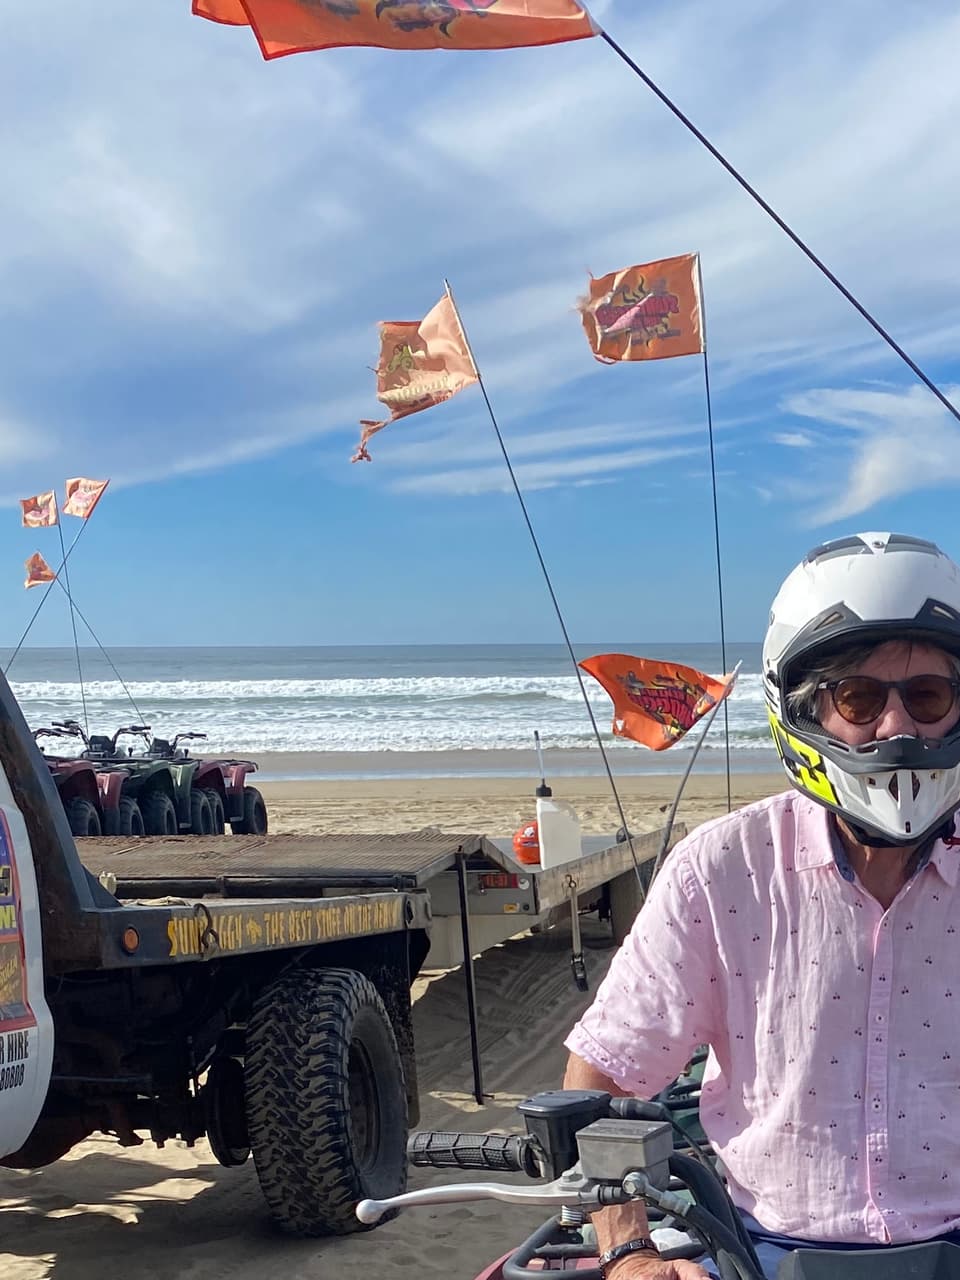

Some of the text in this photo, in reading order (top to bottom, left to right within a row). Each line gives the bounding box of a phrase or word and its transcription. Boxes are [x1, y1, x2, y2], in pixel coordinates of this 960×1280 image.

[264, 911, 285, 945] THE
[288, 910, 312, 941] BEST
[316, 907, 340, 939] STUFF
[358, 904, 371, 932] THE
[7, 1030, 29, 1063] HIRE
